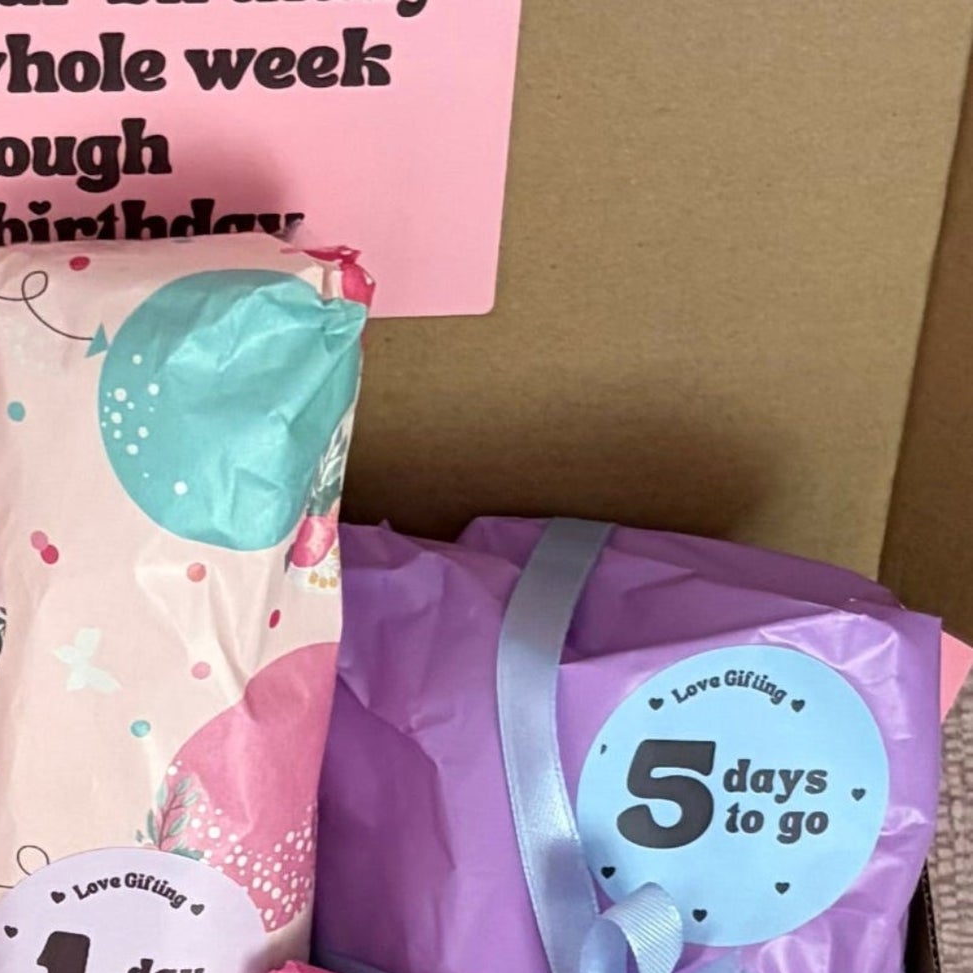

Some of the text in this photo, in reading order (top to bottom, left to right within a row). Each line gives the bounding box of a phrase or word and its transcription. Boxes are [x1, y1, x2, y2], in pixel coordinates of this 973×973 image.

[184, 27, 391, 90] week
[672, 670, 787, 705] Love Gifting
[617, 739, 716, 849] 5
[723, 759, 827, 804] days
[726, 803, 828, 844] to go
[73, 873, 187, 908] Love Gifting
